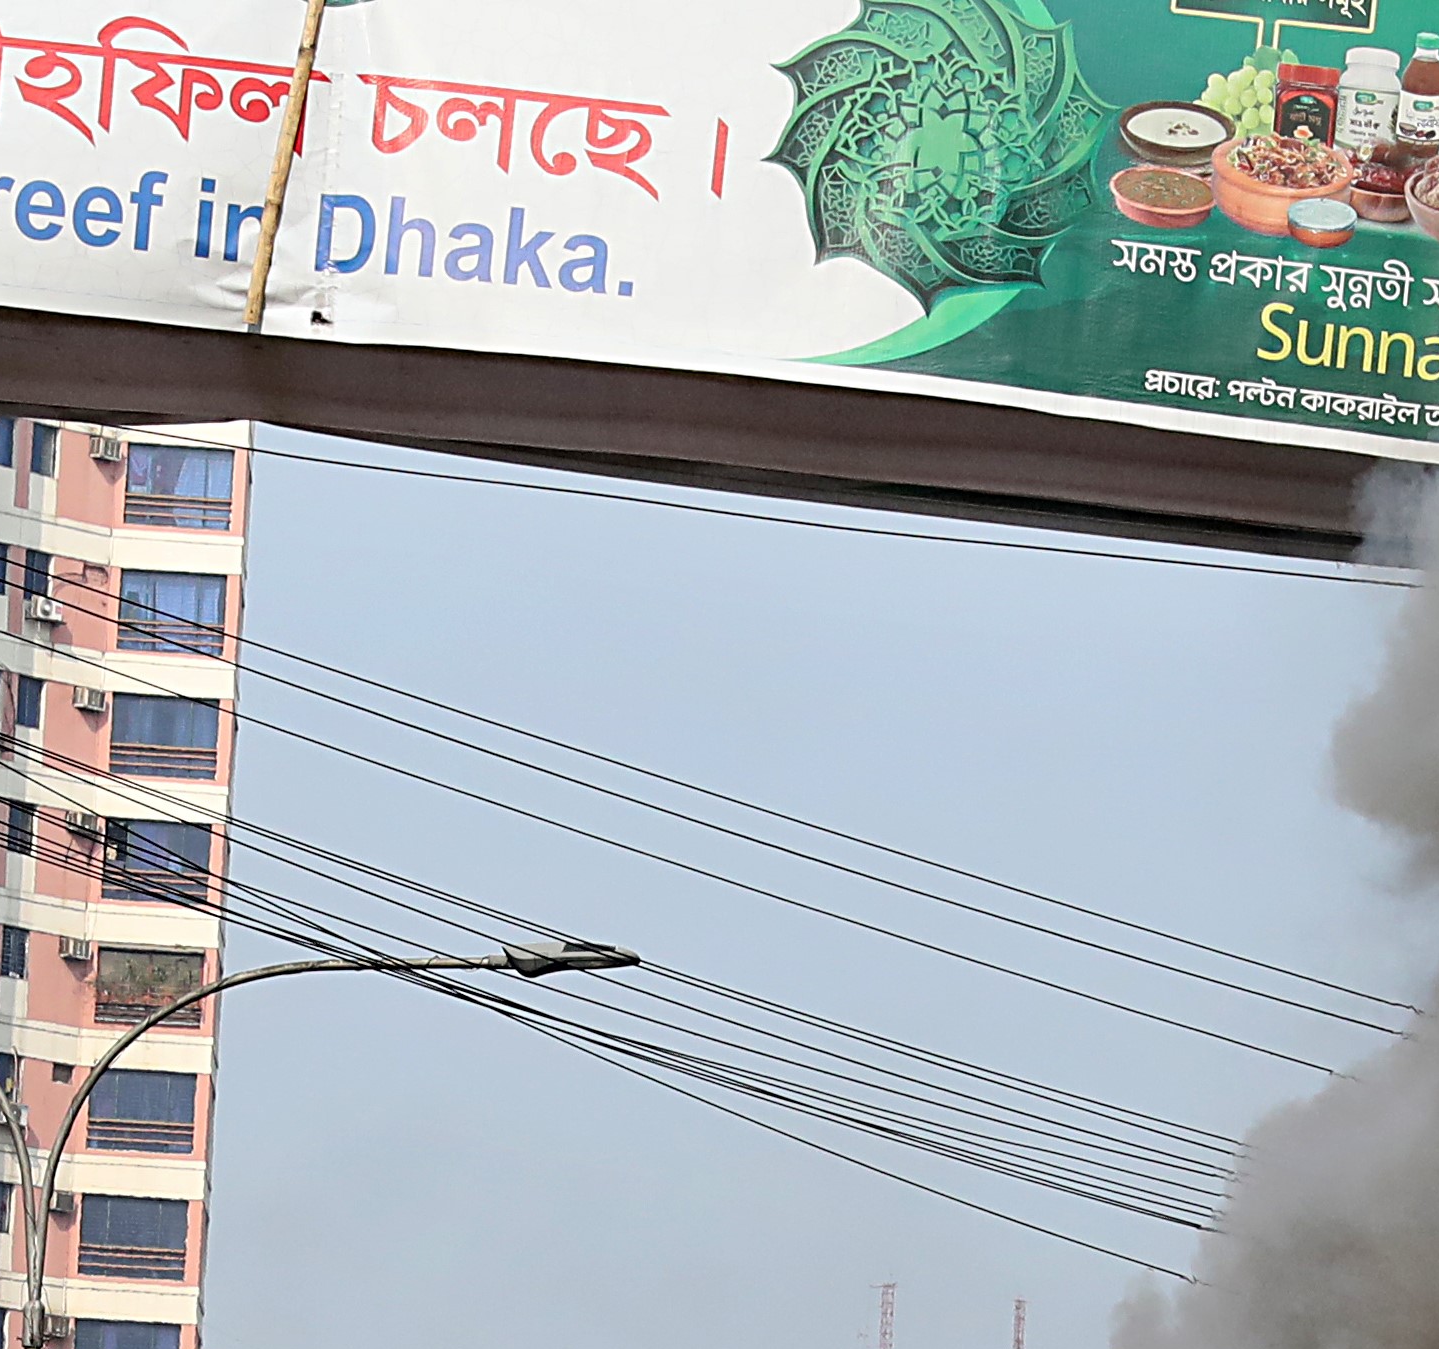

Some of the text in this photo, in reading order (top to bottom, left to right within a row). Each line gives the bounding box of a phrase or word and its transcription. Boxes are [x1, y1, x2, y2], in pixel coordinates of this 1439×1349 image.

[358, 73, 670, 200] চলছে
[194, 178, 267, 264] in
[313, 192, 634, 298] Dhaka.
[1111, 239, 1203, 282] সমস্ত
[1207, 250, 1312, 294] প্রকার
[1320, 258, 1414, 311] সুন্নতী
[1144, 369, 1221, 400] প্রচারে:
[1227, 378, 1296, 411] পল্টন
[1300, 385, 1421, 428] কাকরাইল
